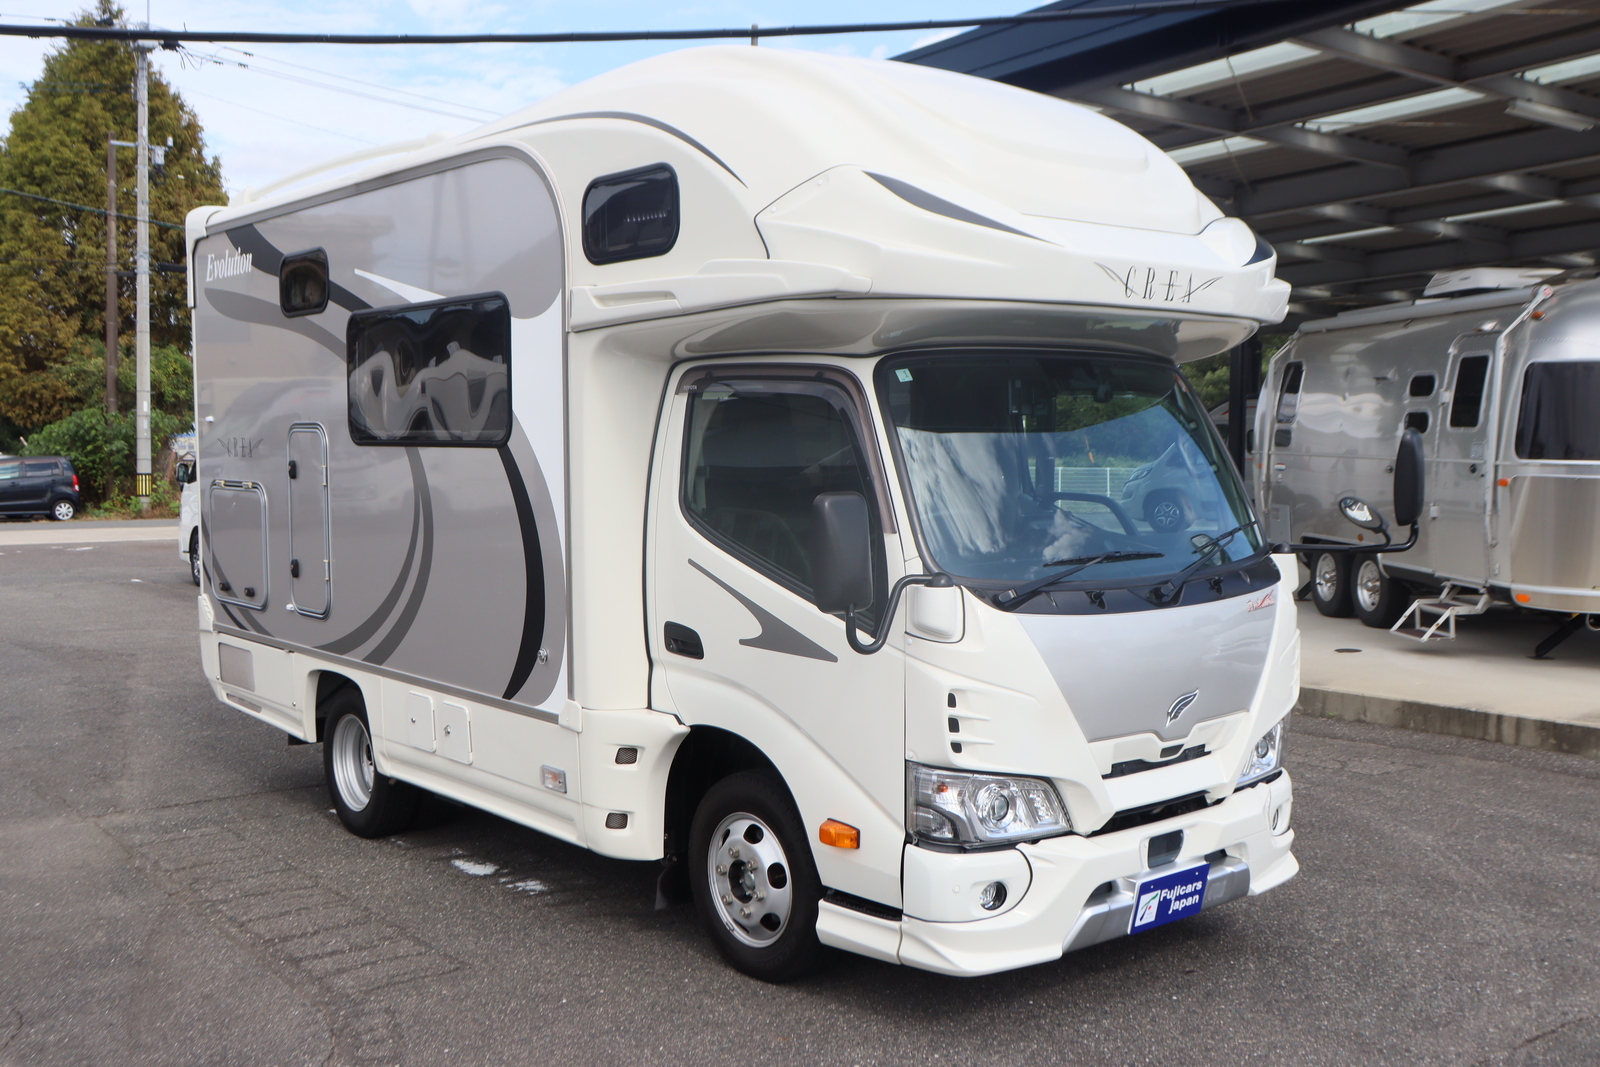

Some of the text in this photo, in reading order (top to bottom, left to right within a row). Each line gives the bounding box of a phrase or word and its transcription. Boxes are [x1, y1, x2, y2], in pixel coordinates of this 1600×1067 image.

[205, 246, 253, 282] Evolution
[1120, 264, 1198, 303] CREA
[1160, 880, 1203, 902] Fujicars
